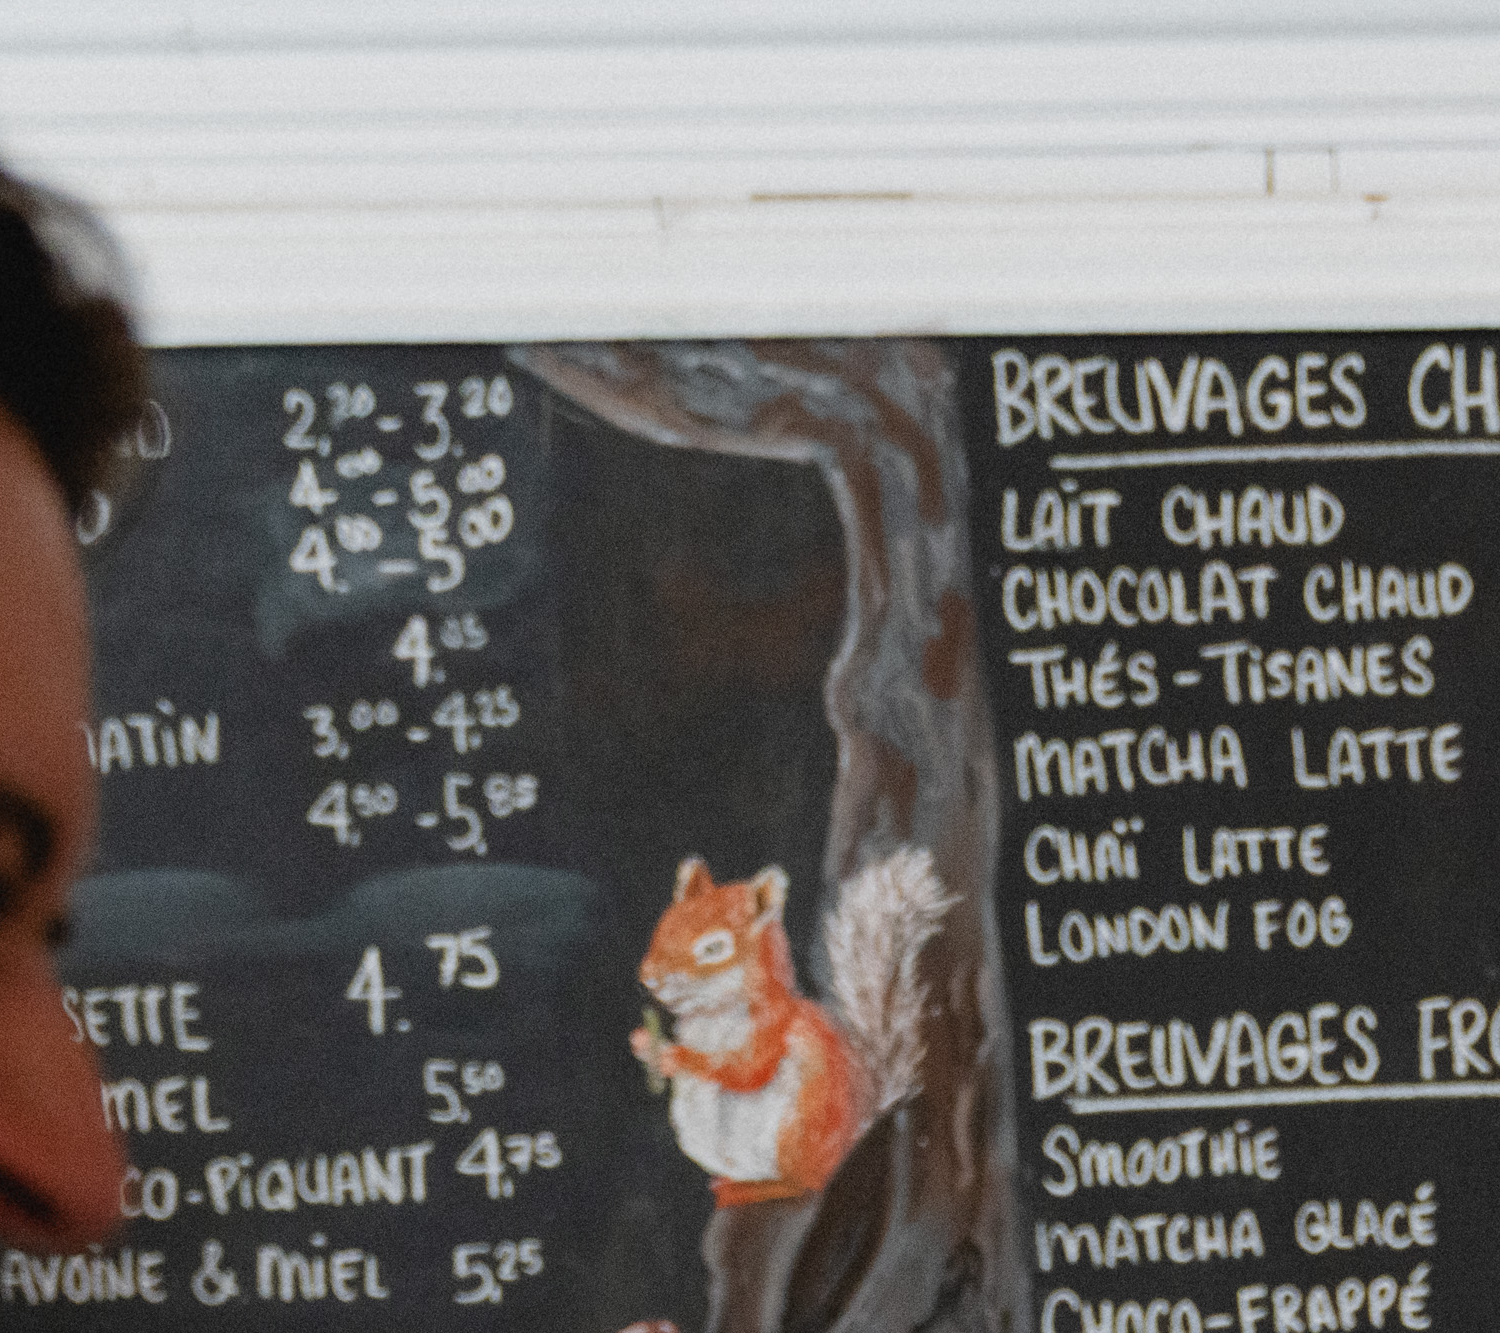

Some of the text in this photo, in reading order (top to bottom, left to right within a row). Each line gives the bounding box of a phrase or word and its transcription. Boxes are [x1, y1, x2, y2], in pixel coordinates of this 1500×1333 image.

[992, 348, 1367, 446] BREUVAGES
[1001, 478, 1122, 552] LAIT
[1161, 484, 1346, 550] CHAUD
[1002, 560, 1279, 631] CHOCOLAT
[1303, 559, 1474, 624] CHAUD
[1200, 634, 1435, 705] TISANES
[1014, 724, 1247, 801] MATCHA
[1290, 723, 1463, 789] LATTE
[1182, 823, 1330, 885] LATTE
[1025, 900, 1229, 966] LONDON
[1254, 896, 1352, 951] FOG
[62, 982, 214, 1052] SETTE
[1028, 1002, 1382, 1100] BREUVAGES
[102, 1077, 232, 1133] MEL
[120, 1139, 434, 1221] CO-PIQUANT
[1041, 1121, 1282, 1197] SMOOTHIE
[1035, 1209, 1266, 1272] MATCHA
[1294, 1182, 1437, 1254] GLACÉ
[192, 1239, 239, 1306] &
[256, 1232, 390, 1303] MIEL
